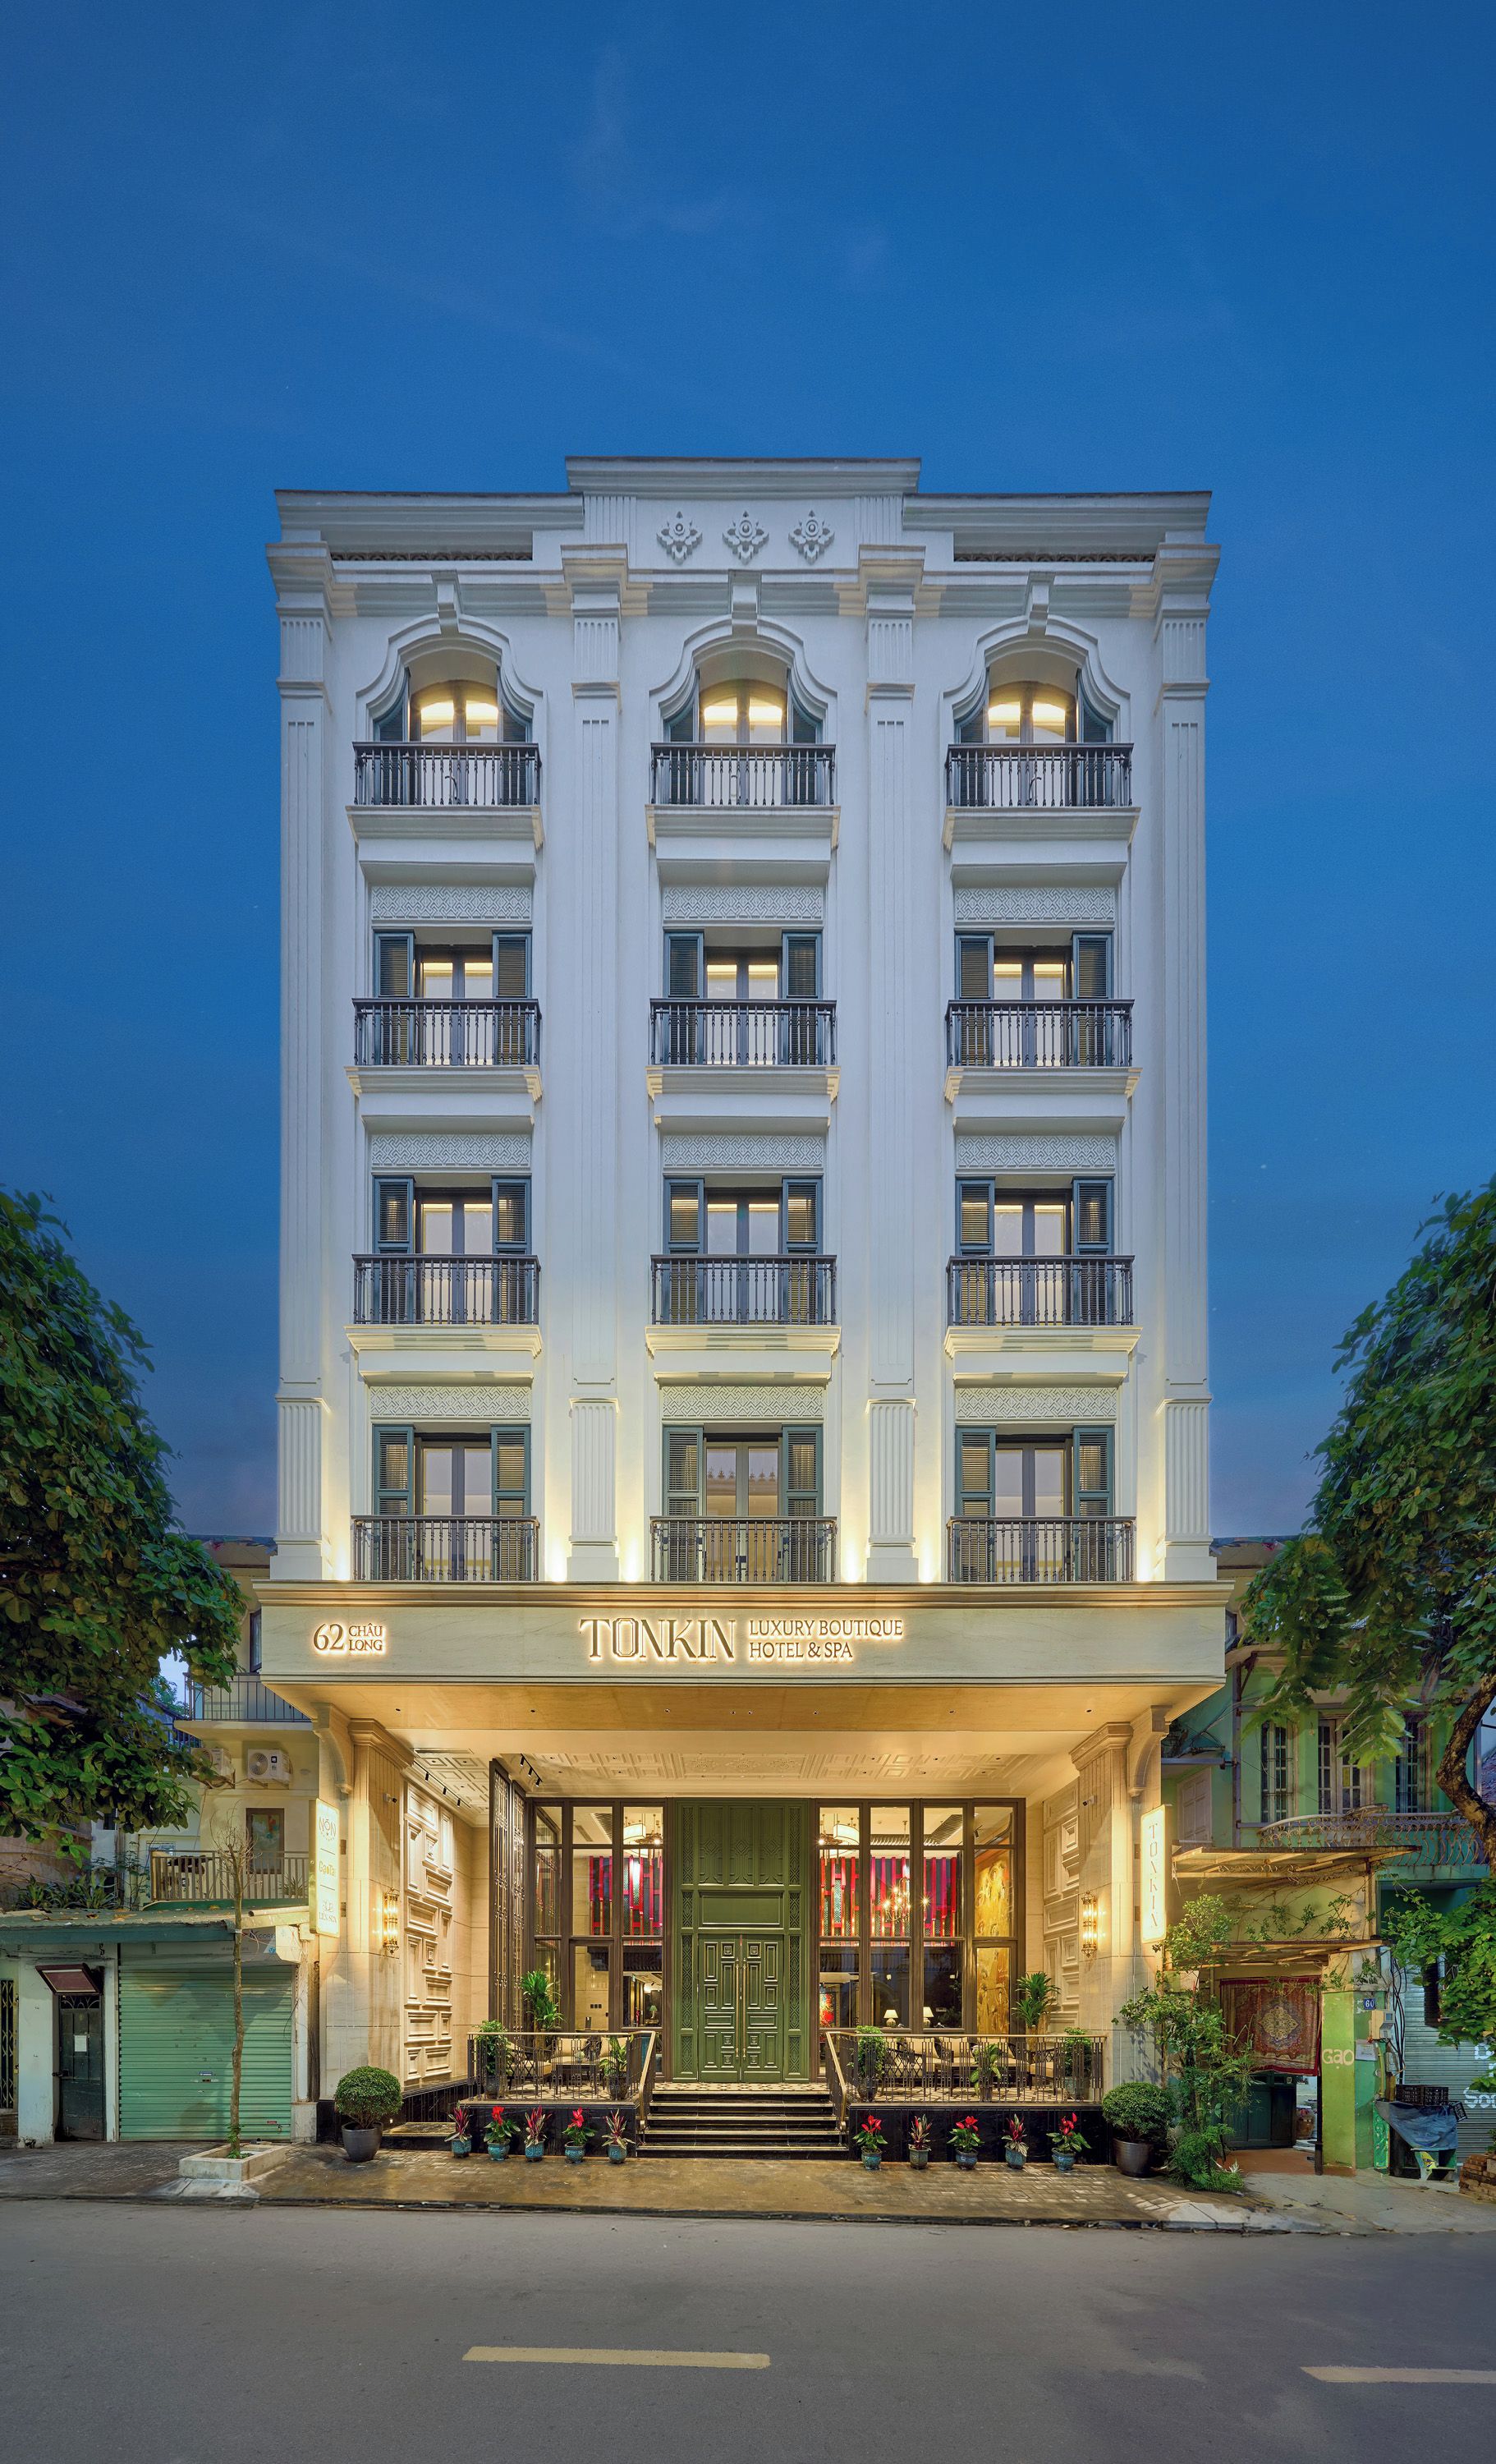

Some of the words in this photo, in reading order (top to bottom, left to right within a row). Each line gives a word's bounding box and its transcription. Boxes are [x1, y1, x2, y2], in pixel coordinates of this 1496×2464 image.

[348, 1622, 383, 1637] CHÂU
[749, 1620, 815, 1636] LUXURY
[819, 1620, 903, 1637] BOUTIQUE
[313, 1623, 345, 1651] 62
[348, 1639, 383, 1651] LONG
[580, 1617, 736, 1658] TONKIN
[749, 1642, 804, 1658] HOTEL
[807, 1642, 821, 1658] &
[824, 1642, 854, 1658] SPA
[1149, 1823, 1159, 1928] TONKIN
[1365, 1999, 1374, 2007] 60
